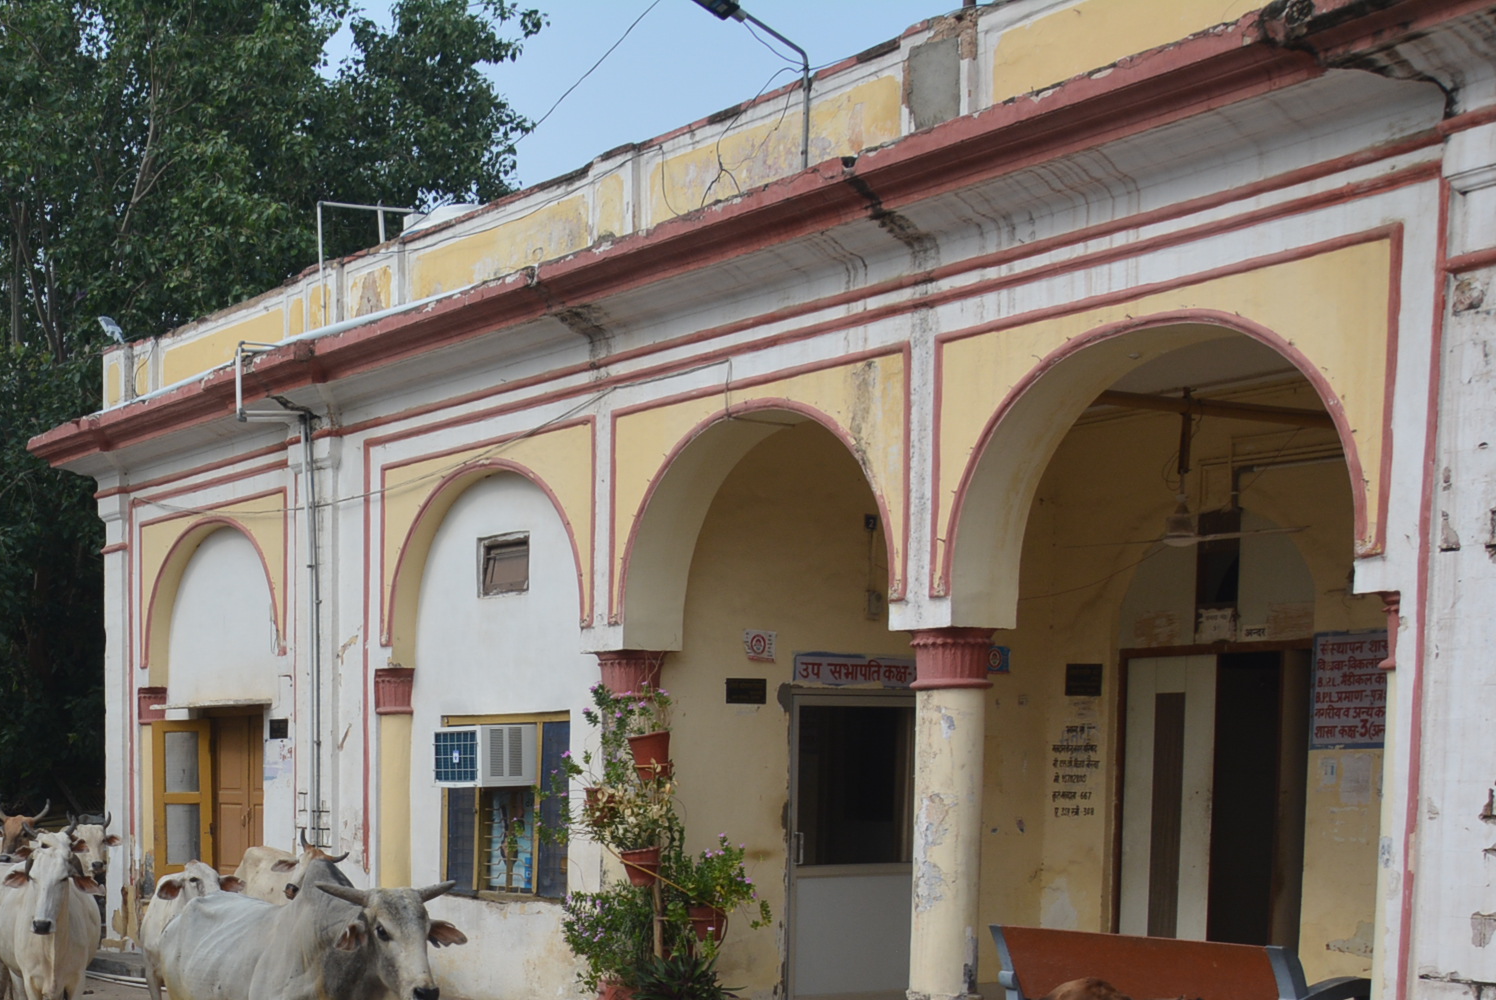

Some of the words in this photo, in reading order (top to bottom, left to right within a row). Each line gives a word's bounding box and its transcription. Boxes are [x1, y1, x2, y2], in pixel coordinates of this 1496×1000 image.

[1244, 627, 1266, 637] अन्दर
[1320, 640, 1367, 656] संस्थापन
[798, 662, 823, 679] उप
[827, 659, 882, 681] सभापति
[1343, 706, 1352, 718] व
[1314, 725, 1338, 739] शाखा
